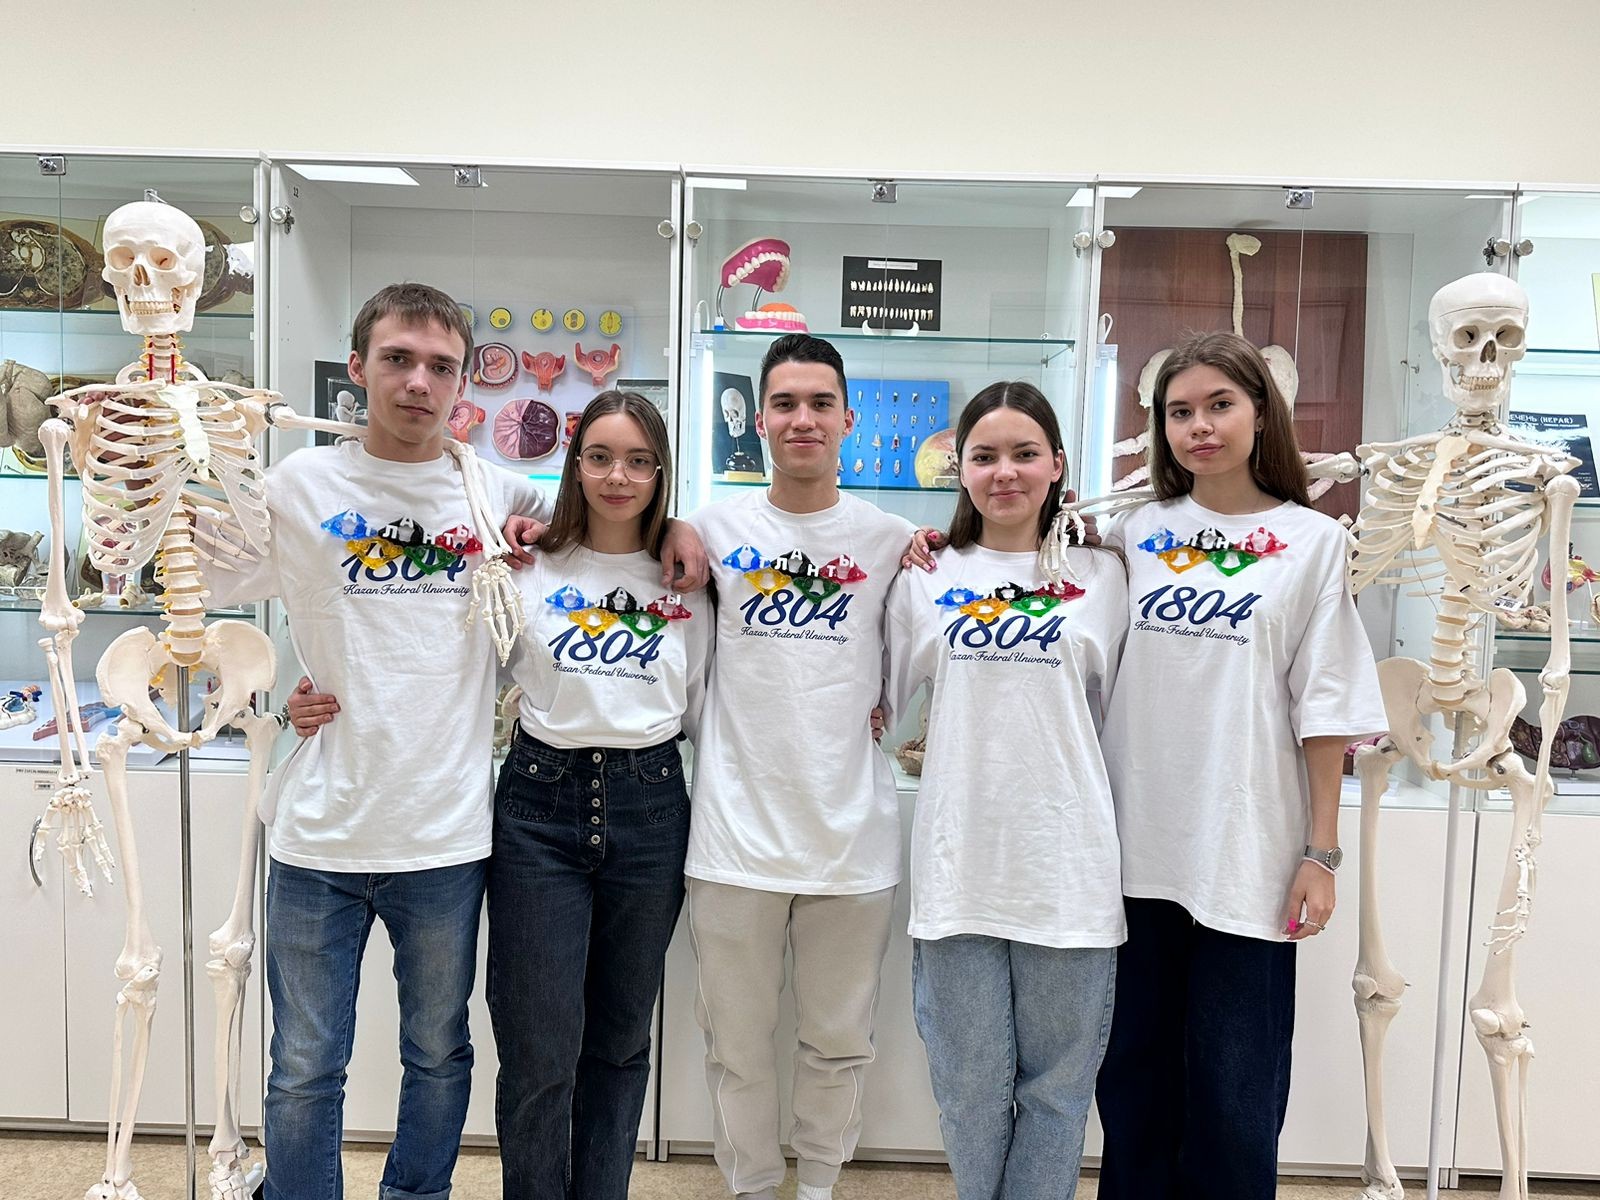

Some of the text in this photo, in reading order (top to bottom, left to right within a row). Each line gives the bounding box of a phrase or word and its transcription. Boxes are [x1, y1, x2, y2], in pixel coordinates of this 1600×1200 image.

[1508, 413, 1538, 422] ЕЧЕНЬ
[741, 543, 856, 578] АТЛАНТЫ
[343, 583, 471, 598] Kazan Federal University
[739, 588, 855, 631] 1804
[1138, 584, 1263, 630] 1804
[740, 626, 850, 645] Kazan Federal University
[944, 614, 1067, 652] 1804
[1134, 620, 1251, 647] Kazan Federal University
[548, 624, 665, 670] 1804
[974, 650, 1014, 662] Federal
[1014, 651, 1063, 668] University
[552, 661, 659, 685] Kazan Federal University
